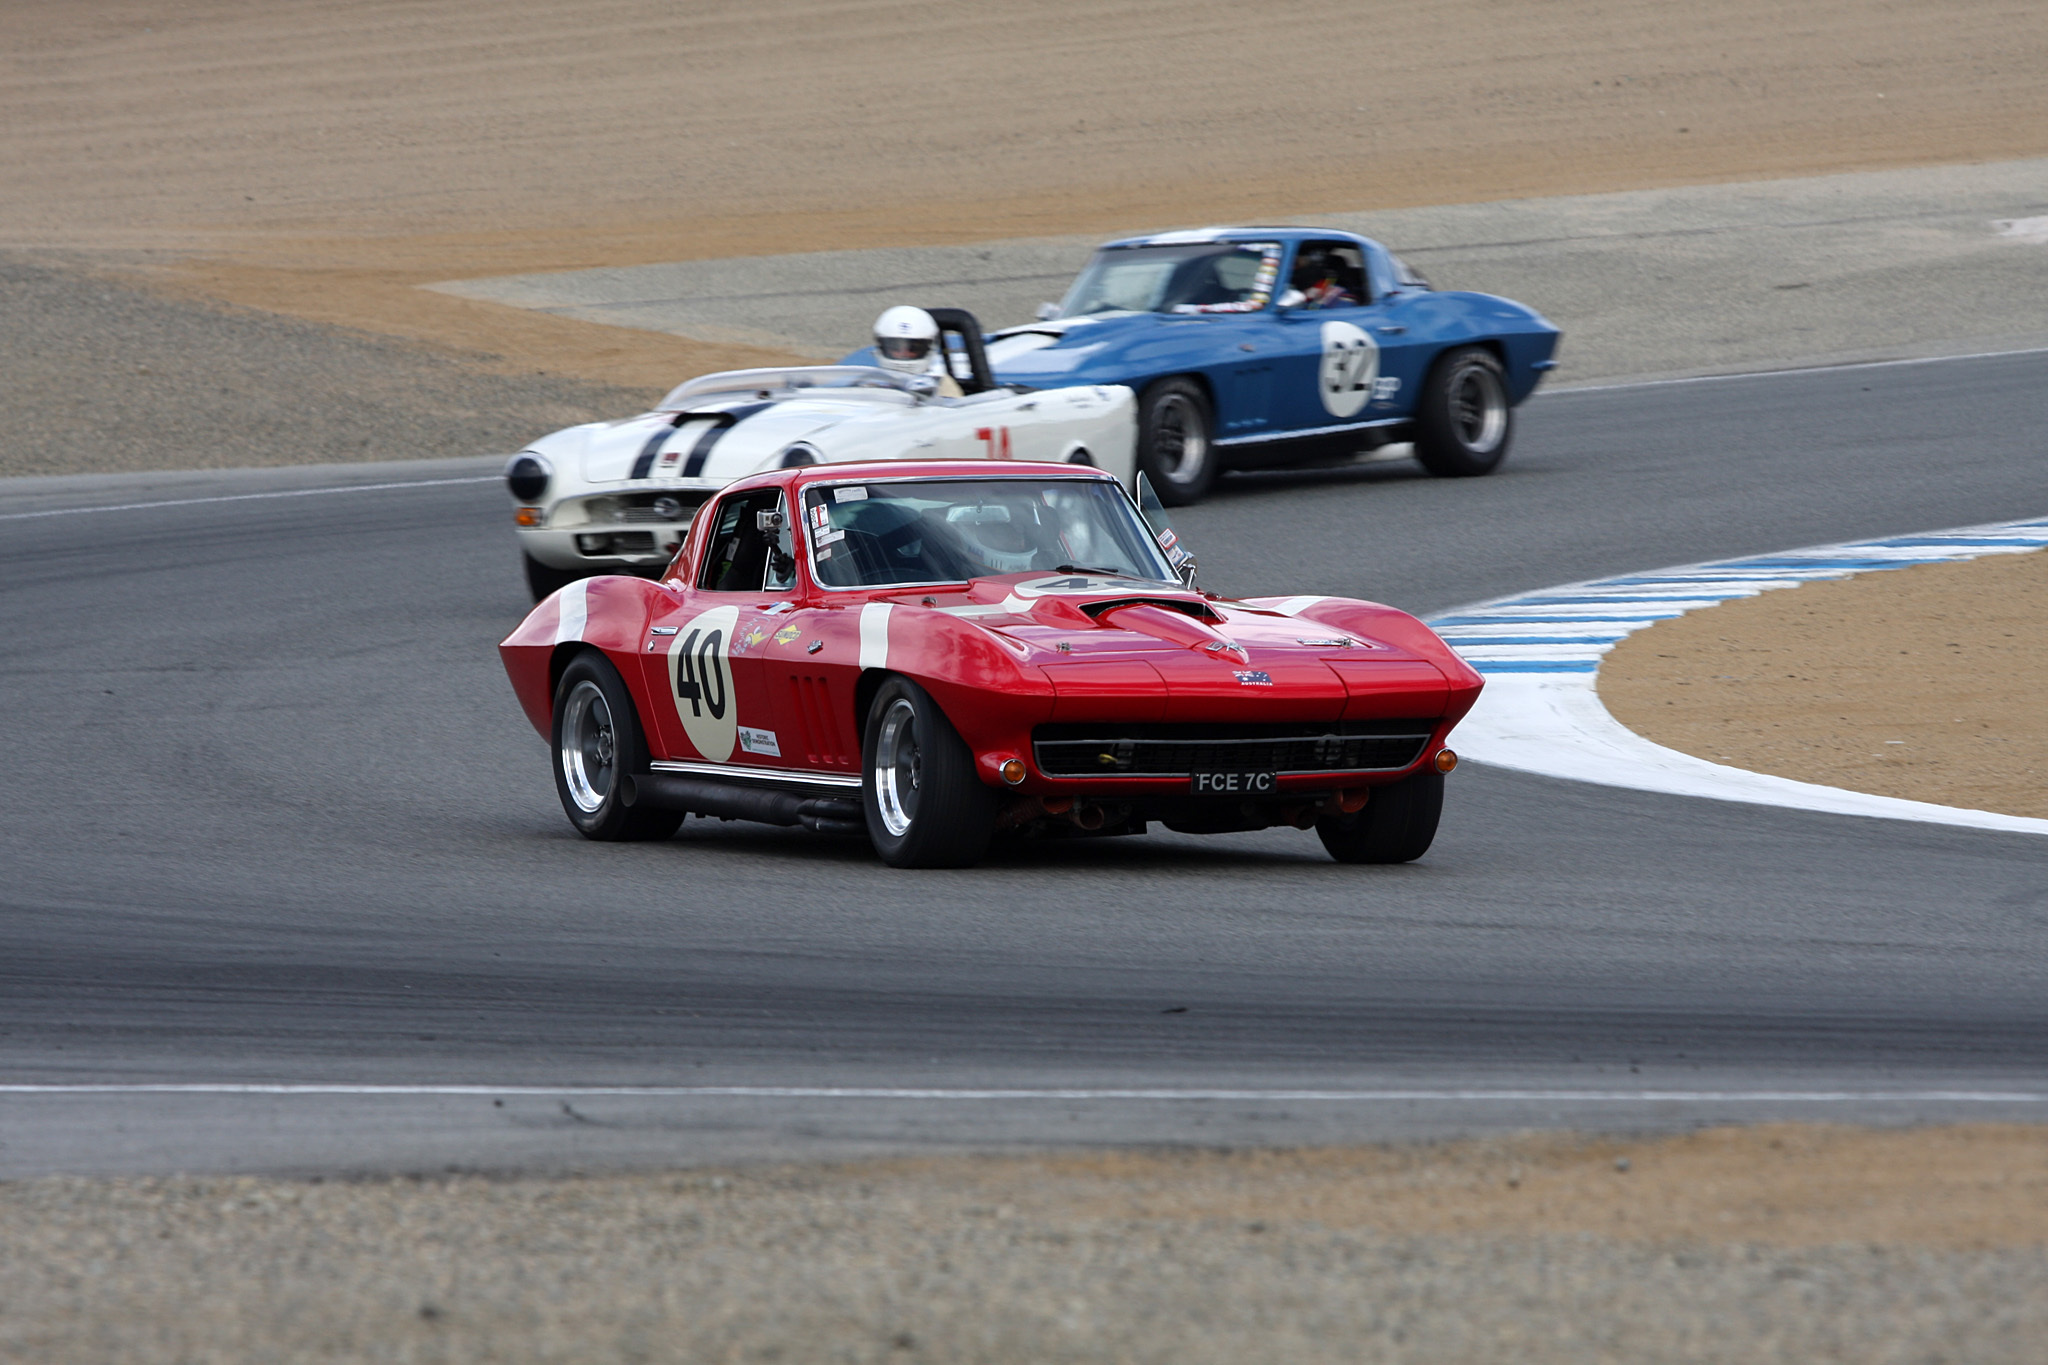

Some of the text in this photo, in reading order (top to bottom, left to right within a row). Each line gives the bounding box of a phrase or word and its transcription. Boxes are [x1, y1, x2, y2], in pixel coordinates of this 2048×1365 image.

[1324, 340, 1375, 393] 32
[677, 628, 726, 720] 40
[1198, 773, 1270, 791] FCE 7C
